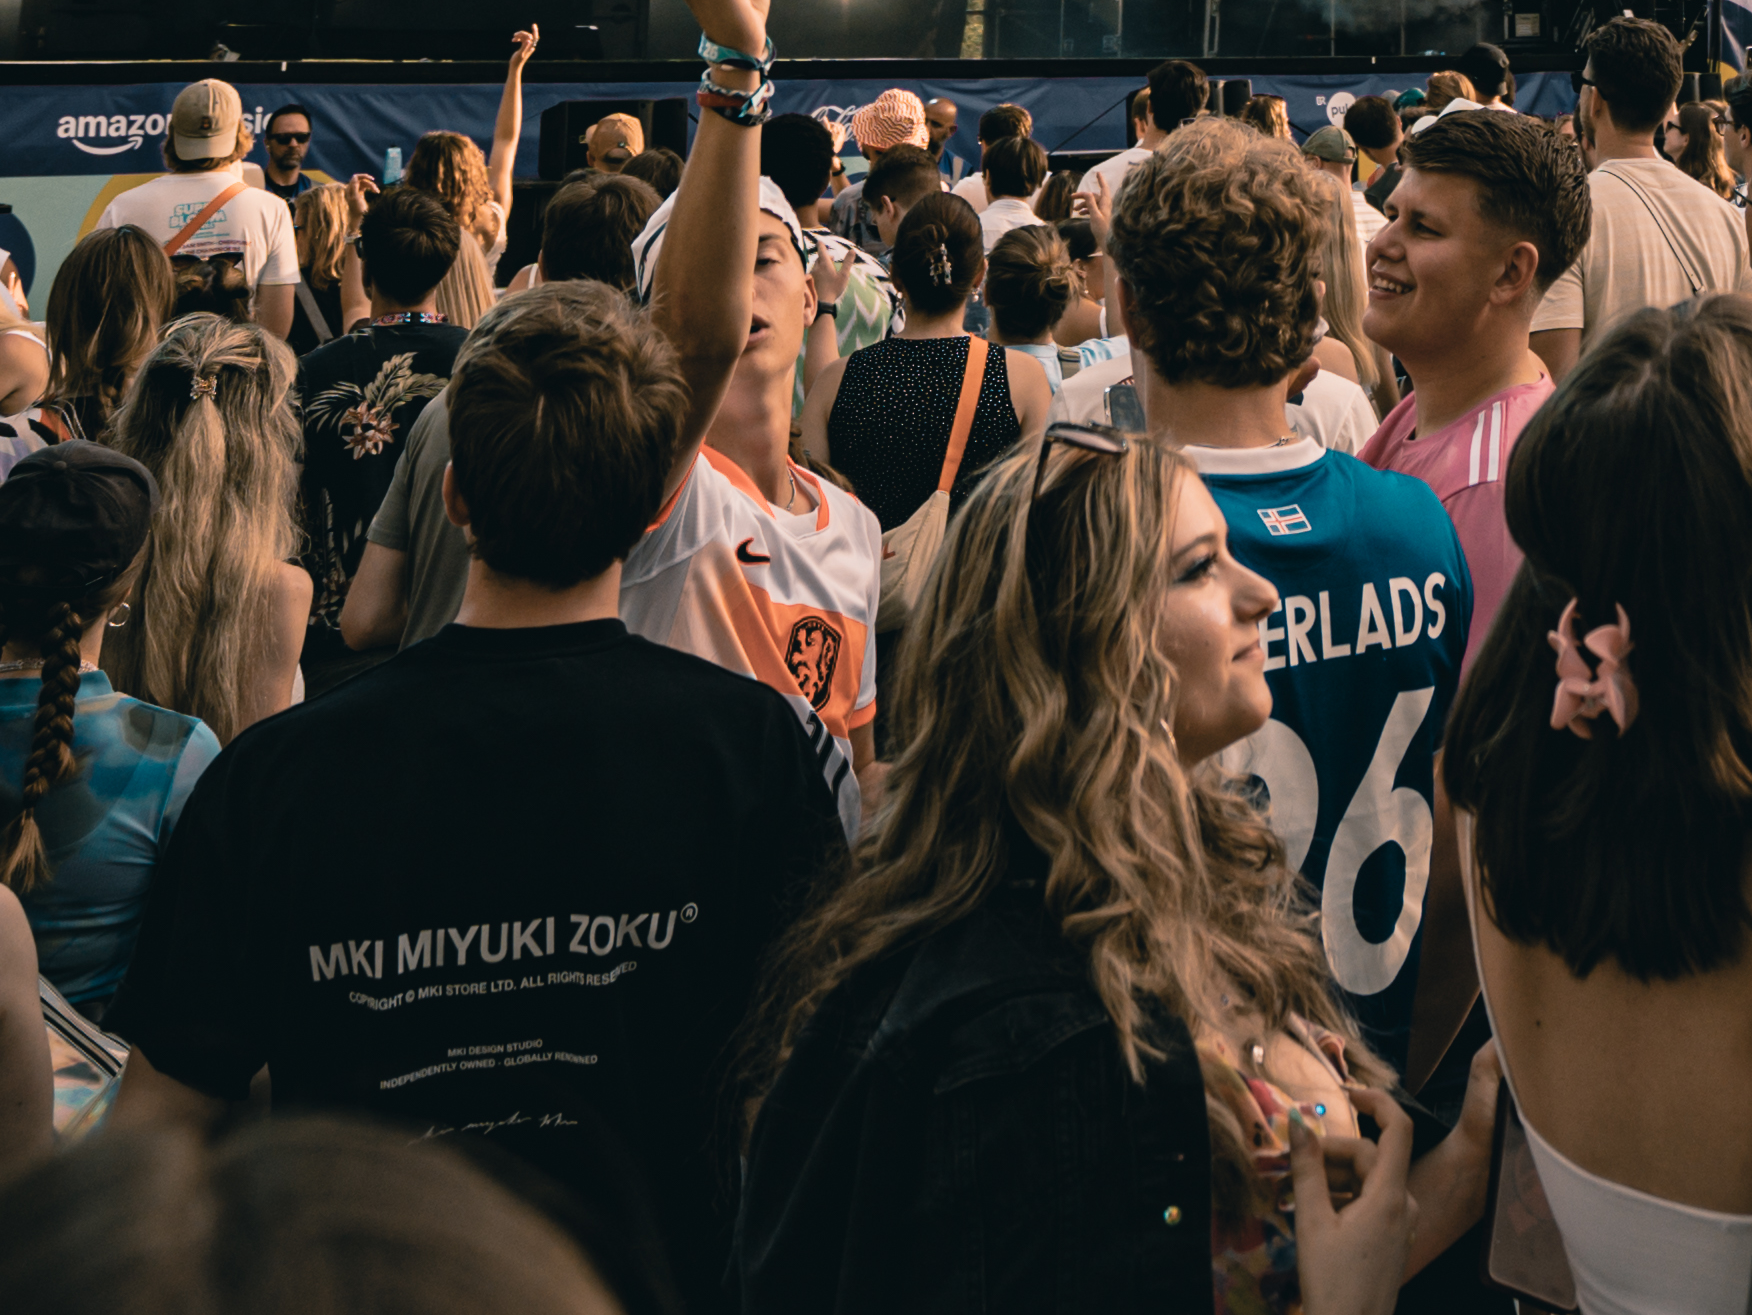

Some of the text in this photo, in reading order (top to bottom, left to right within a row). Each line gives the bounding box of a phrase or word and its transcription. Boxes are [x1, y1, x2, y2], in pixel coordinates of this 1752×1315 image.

[57, 113, 172, 139] amazo
[1258, 572, 1446, 672] ERLADS
[309, 939, 384, 982] MKI
[397, 916, 555, 975] MIYUKI
[418, 984, 442, 1000] MKI
[445, 981, 487, 996] STORE
[520, 975, 545, 989] ALL
[468, 1044, 504, 1056] DESIGN
[506, 1038, 543, 1052] STUDIO
[459, 1058, 495, 1070] OWNED
[503, 1051, 553, 1067] GLOBALLY
